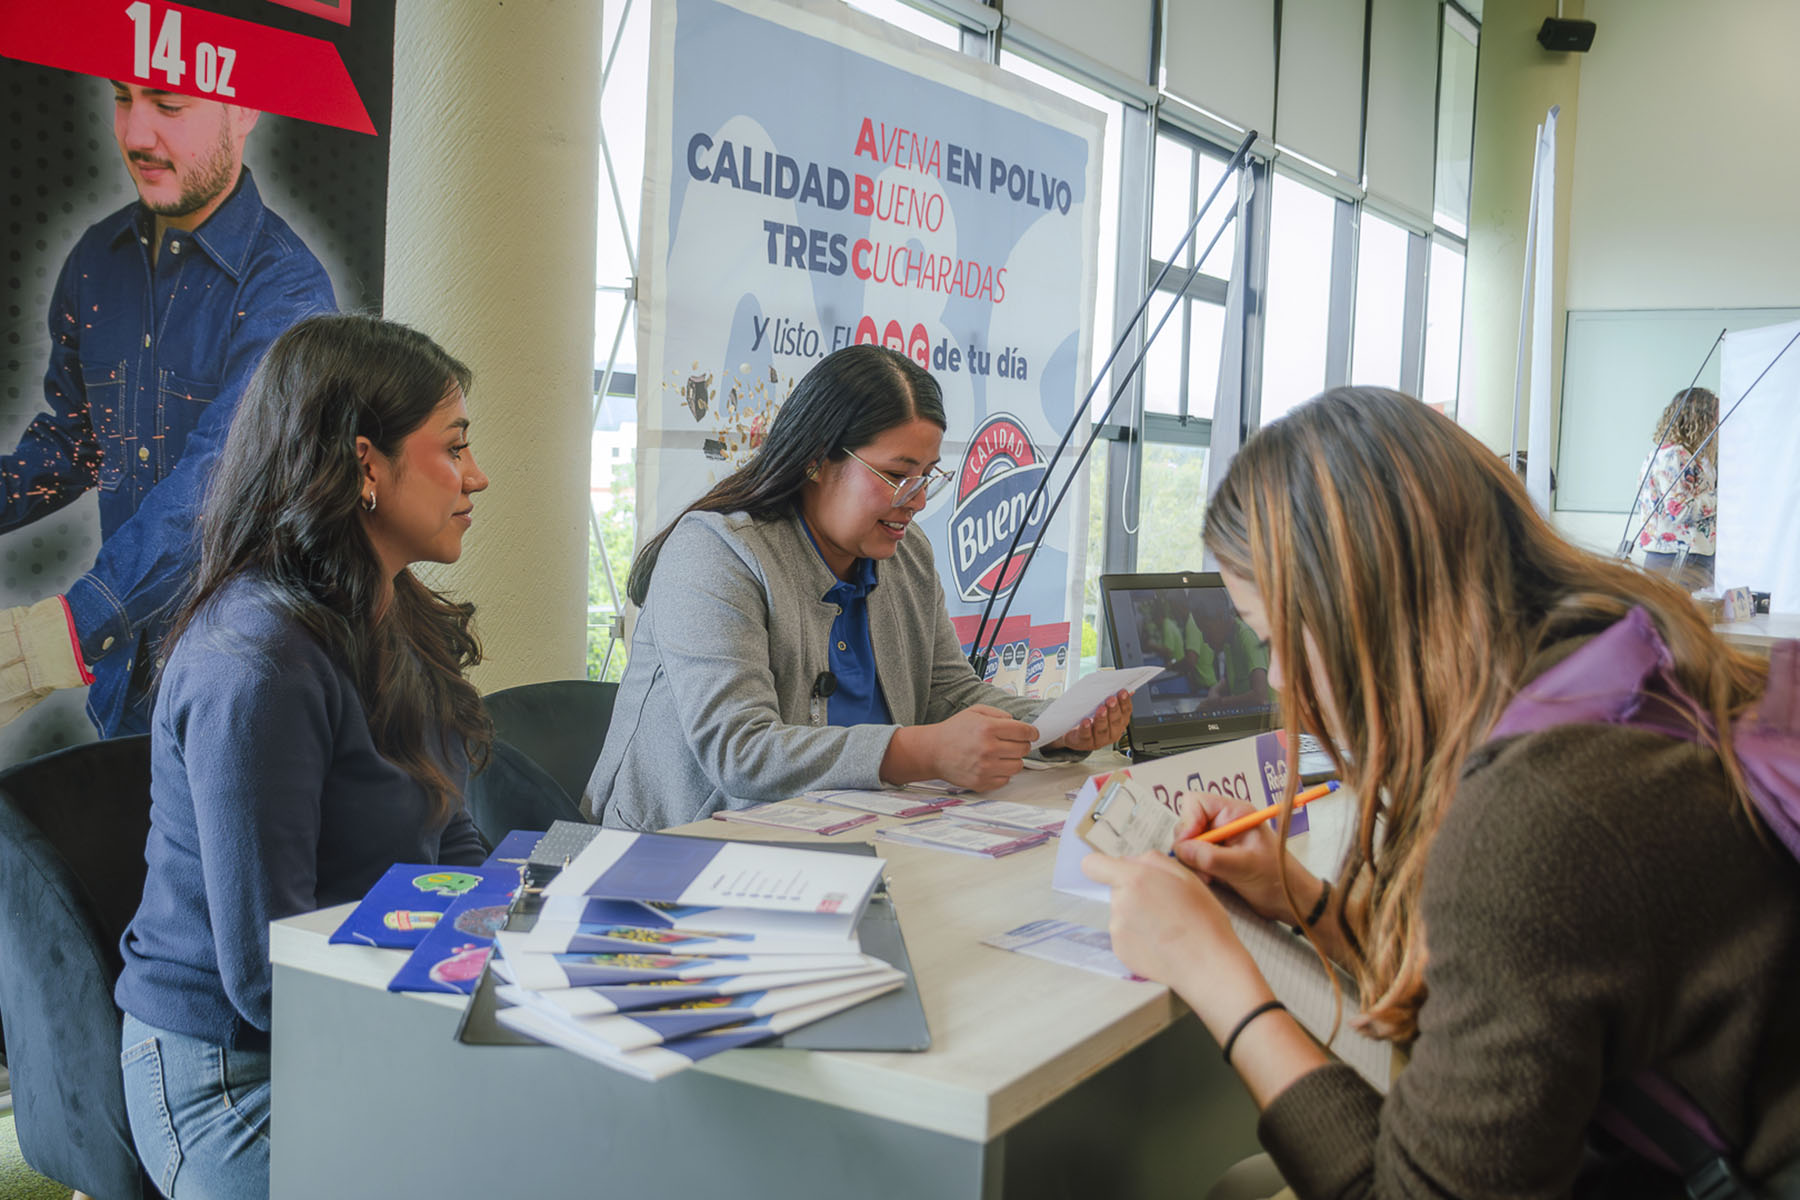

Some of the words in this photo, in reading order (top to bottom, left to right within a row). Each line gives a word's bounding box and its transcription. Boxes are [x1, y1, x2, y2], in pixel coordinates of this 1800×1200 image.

[125, 1, 186, 86] 14
[687, 132, 850, 211] CALIDAD
[853, 173, 944, 232] BUENO
[854, 117, 941, 178] AVENA
[946, 143, 982, 190] EN
[990, 156, 1072, 216] POLVO
[763, 219, 848, 276] TRES
[851, 238, 1007, 303] CUCHARADAS
[773, 317, 824, 358] listo.
[933, 338, 961, 372] de
[968, 345, 990, 376] tu
[997, 347, 1028, 380] día
[969, 428, 1024, 474] CALIDAD
[957, 487, 1046, 573] Bueno
